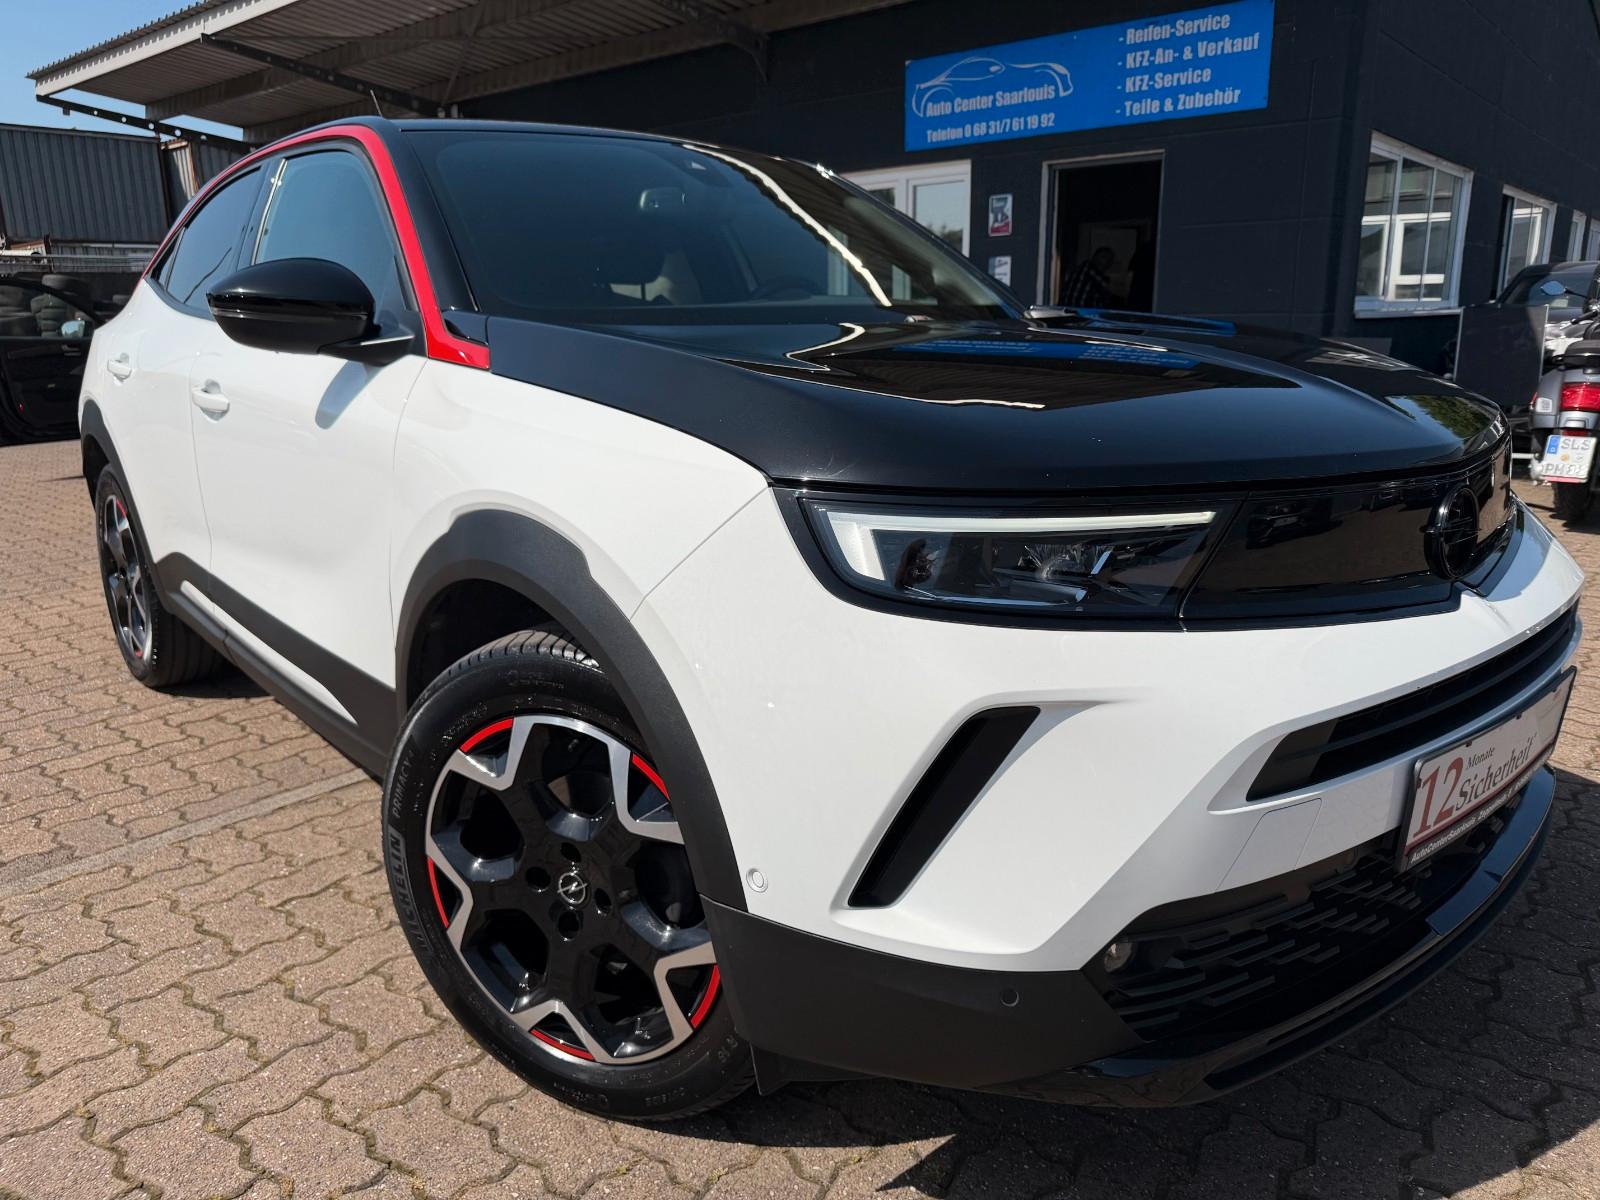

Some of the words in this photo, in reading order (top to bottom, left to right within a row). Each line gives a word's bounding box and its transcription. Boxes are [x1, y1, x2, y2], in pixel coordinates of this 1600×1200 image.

[1126, 14, 1231, 45] Reifen-Service
[1126, 47, 1179, 69] KFZ-An-
[1183, 46, 1193, 60] &
[1197, 32, 1260, 58] Verkauf
[1125, 67, 1212, 93] KFZ-Service
[926, 102, 951, 117] Auto
[954, 96, 993, 113] Center
[995, 84, 1056, 107] Saarlouis
[1124, 98, 1160, 117] Teile
[1163, 97, 1174, 112] &
[1177, 87, 1241, 110] Zubehör
[926, 127, 963, 143] Telefon
[1040, 112, 1055, 126] 92
[1560, 438, 1591, 451] SLS
[1465, 747, 1496, 769] Monate
[1413, 757, 1464, 838] 12
